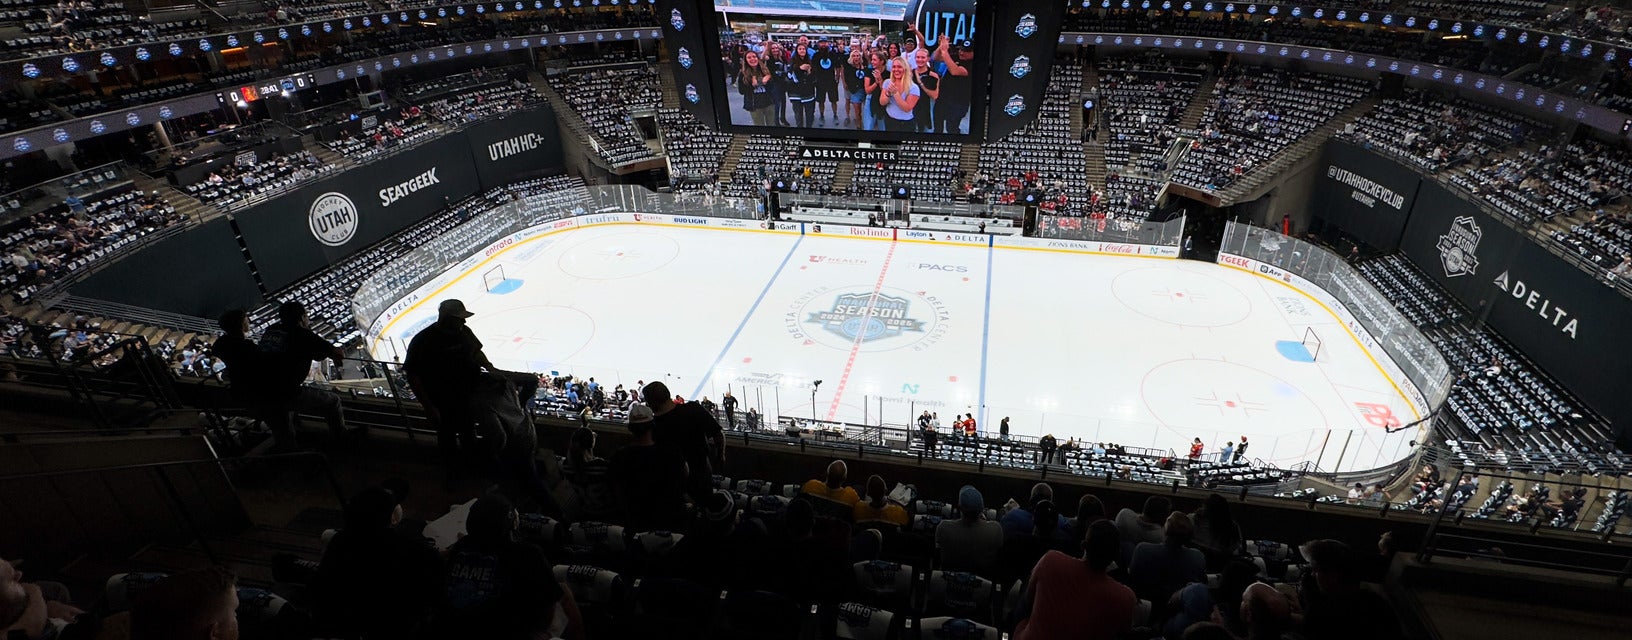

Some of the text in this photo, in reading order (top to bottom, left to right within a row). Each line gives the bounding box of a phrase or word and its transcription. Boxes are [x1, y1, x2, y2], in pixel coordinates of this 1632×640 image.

[297, 78, 305, 88] 0
[230, 91, 239, 102] 0
[488, 133, 545, 162] UTAH HC+
[814, 149, 896, 161] DELTA CENTER
[378, 166, 440, 208] SEATGEEK
[1327, 165, 1405, 211] @UTAHHOCKEYCLUB
[316, 198, 344, 214] HOCKEY
[316, 207, 351, 234] UTAH
[330, 229, 350, 241] CLUB
[905, 230, 927, 238] Layton
[954, 235, 985, 243] DELTA
[1448, 230, 1475, 256] SEASON
[485, 238, 513, 257] entrata
[918, 263, 968, 273] PACS
[1219, 254, 1250, 268] TGEEK
[392, 294, 419, 315] DELTA
[834, 304, 904, 319] SEASON
[838, 297, 904, 310] INAUURAL
[926, 296, 949, 321] DELTA
[1511, 279, 1580, 341] DELTA
[784, 312, 804, 341] DELTA
[1353, 325, 1373, 349] DELTA
[448, 562, 493, 581] GAME
